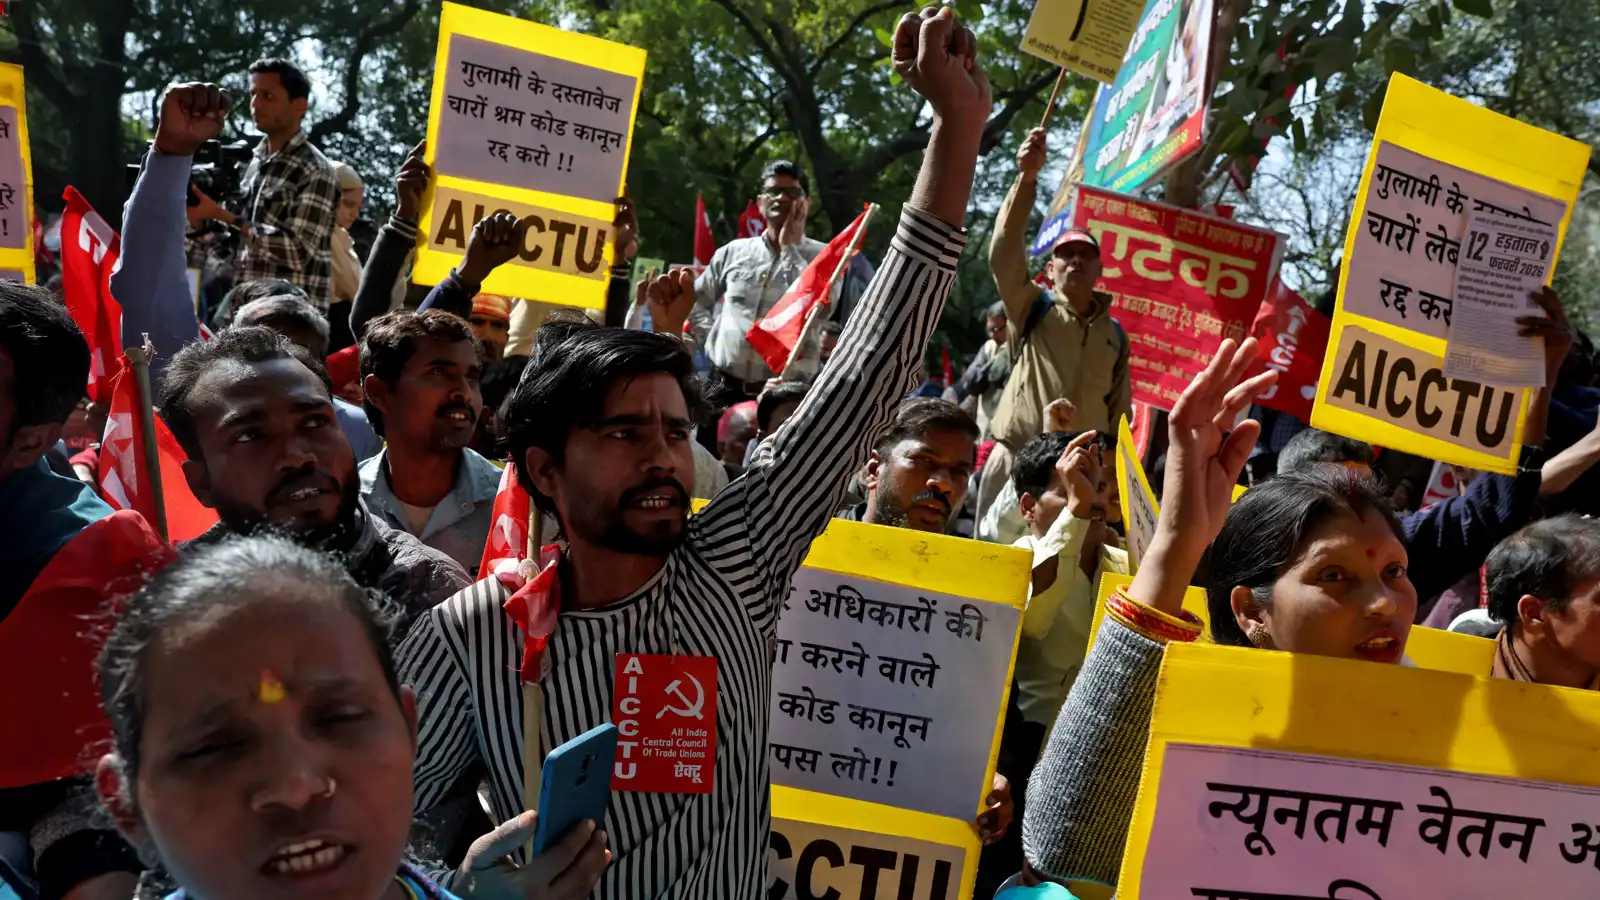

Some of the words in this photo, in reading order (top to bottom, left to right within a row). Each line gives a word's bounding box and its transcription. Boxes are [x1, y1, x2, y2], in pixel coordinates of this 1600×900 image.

[461, 60, 522, 91] गुलामी
[528, 71, 547, 95] के
[552, 83, 622, 114] दस्तावेज
[447, 94, 489, 119] चारों
[494, 105, 525, 127] श्रम
[531, 111, 568, 137] कोड
[573, 123, 623, 153] कानून
[487, 139, 510, 163] रद्द
[516, 144, 550, 167] करो
[558, 153, 574, 172] !!
[1376, 164, 1442, 207] गुलामी
[1446, 182, 1468, 215] के
[434, 199, 607, 274] ACTU
[1087, 218, 1257, 300] एटक
[1367, 210, 1421, 254] चारों
[1425, 225, 1461, 267] लेब
[1466, 230, 1489, 262] 12
[1495, 232, 1540, 255] हड़ताल
[1489, 255, 1520, 273] फरवरी
[1520, 262, 1544, 278] 2026
[1379, 278, 1412, 319] रद्द
[1419, 290, 1453, 328] कर
[1332, 340, 1515, 448] AICCTU
[805, 584, 937, 634] अधिकारों
[944, 603, 989, 642] की
[800, 641, 869, 678] करने
[878, 652, 941, 689] वाले
[614, 656, 644, 779] AICCTU
[642, 737, 674, 748] Central
[676, 738, 707, 748] Council
[671, 728, 683, 737] All
[686, 728, 708, 738] India
[778, 686, 840, 725] कोड
[848, 703, 933, 749] कानून
[642, 748, 653, 757] Of
[655, 748, 677, 758] Trade
[679, 750, 705, 759] Unions
[769, 742, 822, 774] पस
[1206, 781, 1403, 857] न्यूनतम
[1416, 786, 1546, 864] वेतन
[768, 830, 952, 900] CCTU
